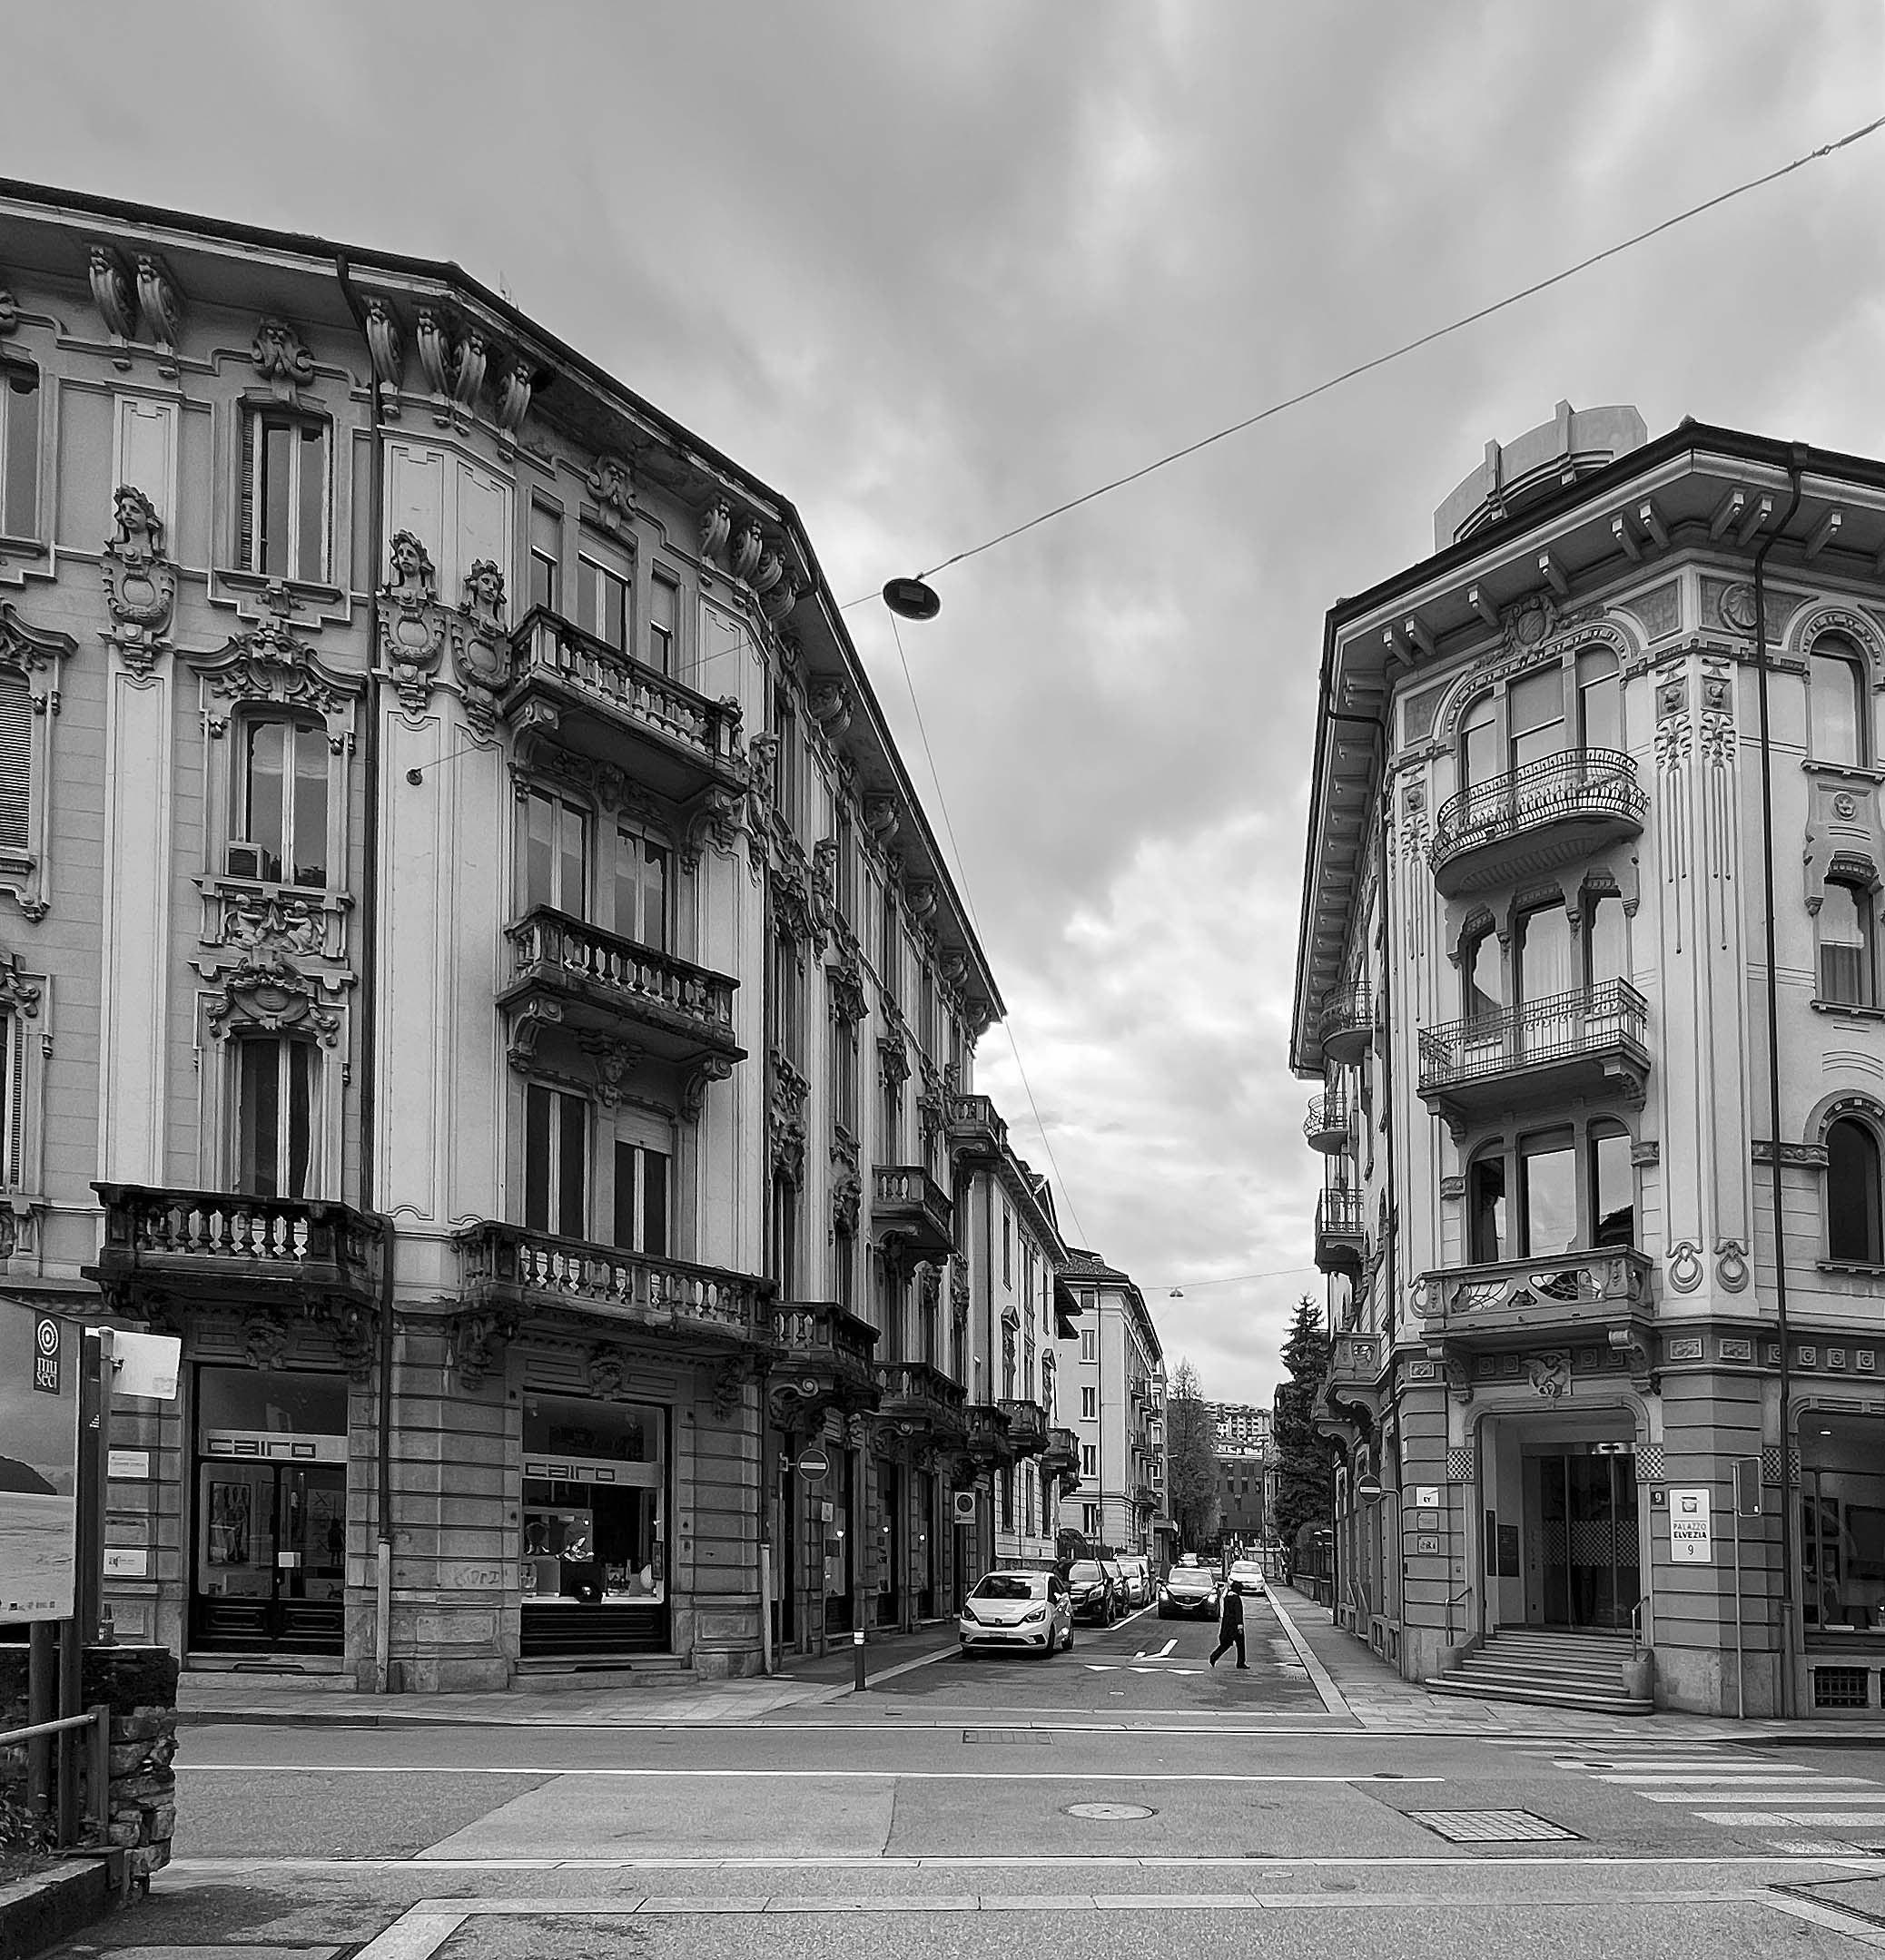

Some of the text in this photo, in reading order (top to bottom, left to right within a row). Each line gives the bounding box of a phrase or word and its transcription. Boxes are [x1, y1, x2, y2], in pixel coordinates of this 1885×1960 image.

[36, 1357, 58, 1374] mu
[208, 1438, 316, 1458] cairo
[525, 1462, 616, 1482] cairo
[1654, 1492, 1663, 1503] 9
[1673, 1522, 1708, 1532] PALAZZO
[1673, 1531, 1708, 1540] ELVEZIA
[1687, 1544, 1694, 1555] 9
